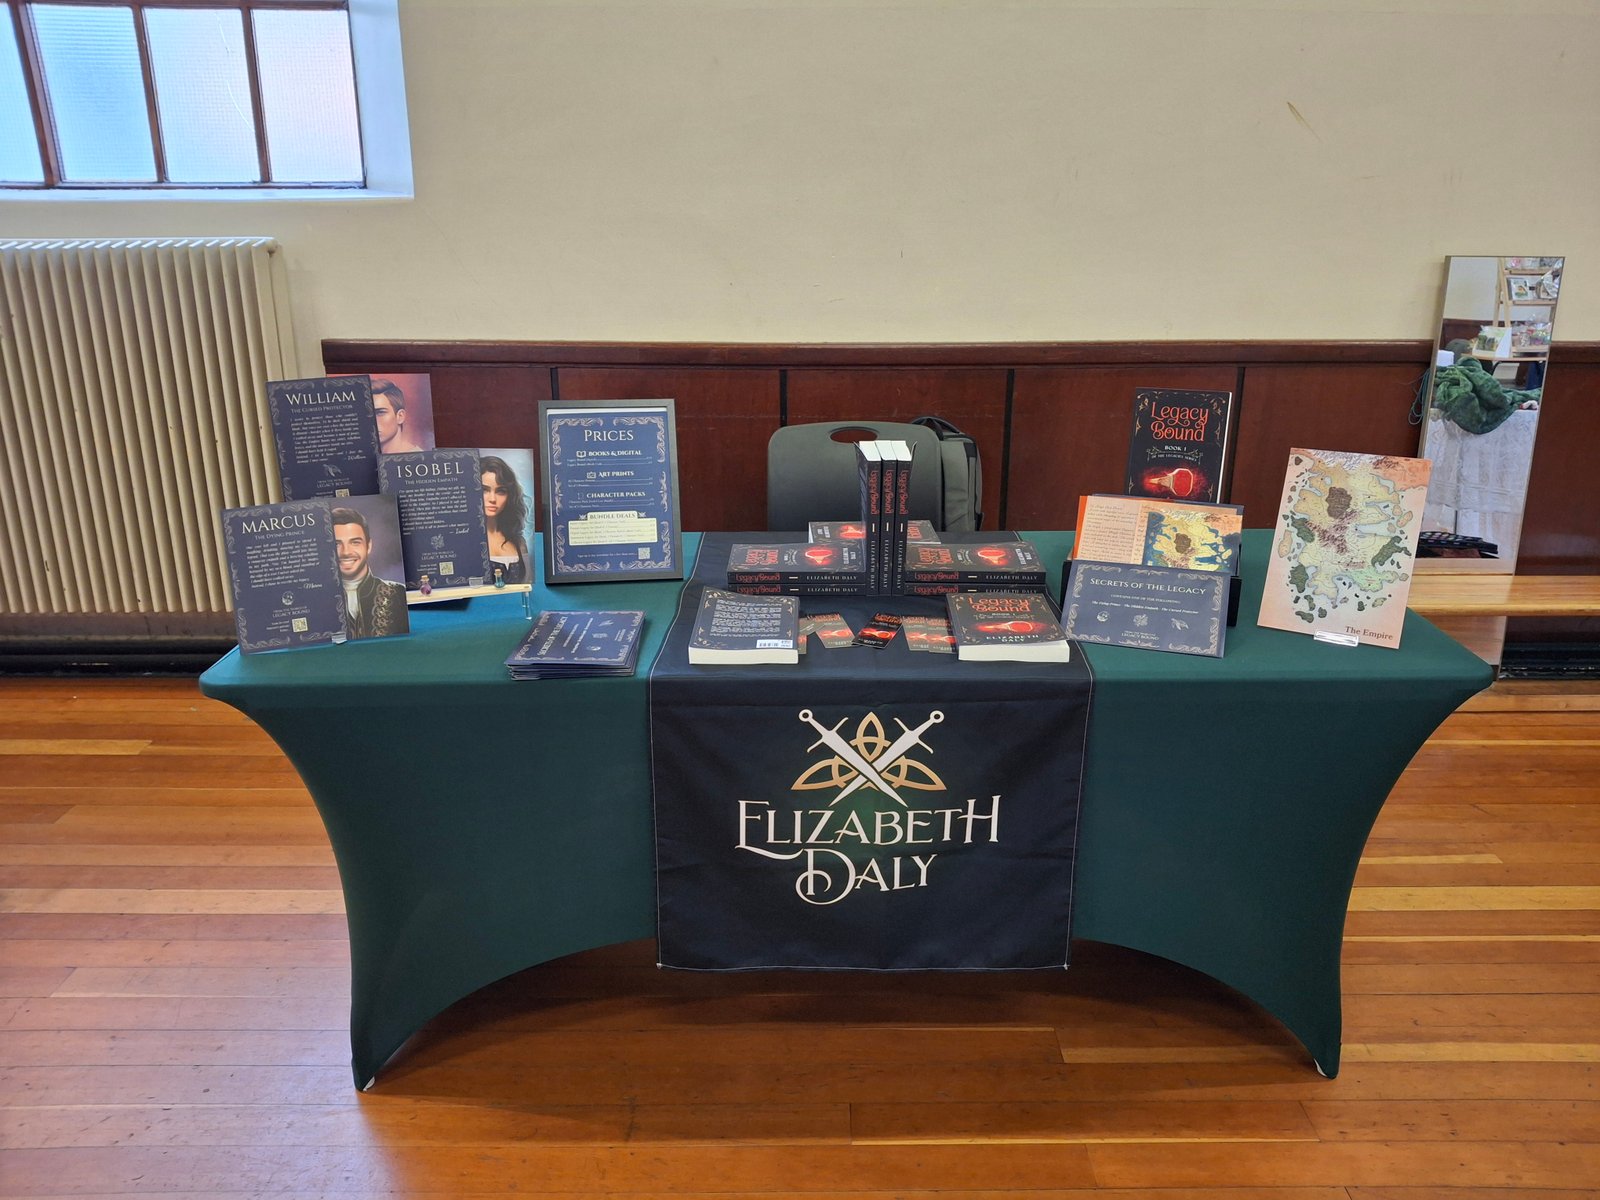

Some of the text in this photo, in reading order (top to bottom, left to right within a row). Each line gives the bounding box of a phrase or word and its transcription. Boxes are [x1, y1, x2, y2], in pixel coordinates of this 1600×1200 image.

[286, 391, 356, 405] WILLIAM
[1151, 402, 1208, 428] Legacy
[584, 430, 634, 442] PRICES
[1150, 420, 1205, 442] Bound
[397, 462, 464, 478] ISOBEL
[242, 513, 316, 534] MARCUS
[1090, 578, 1128, 588] SECRETS
[1167, 585, 1206, 595] LEGACY
[968, 597, 1028, 608] Legacy
[972, 602, 1030, 612] Bound
[1345, 626, 1393, 640] The Empire
[734, 794, 1002, 860] ELIZABETH
[795, 848, 938, 905] DALY
